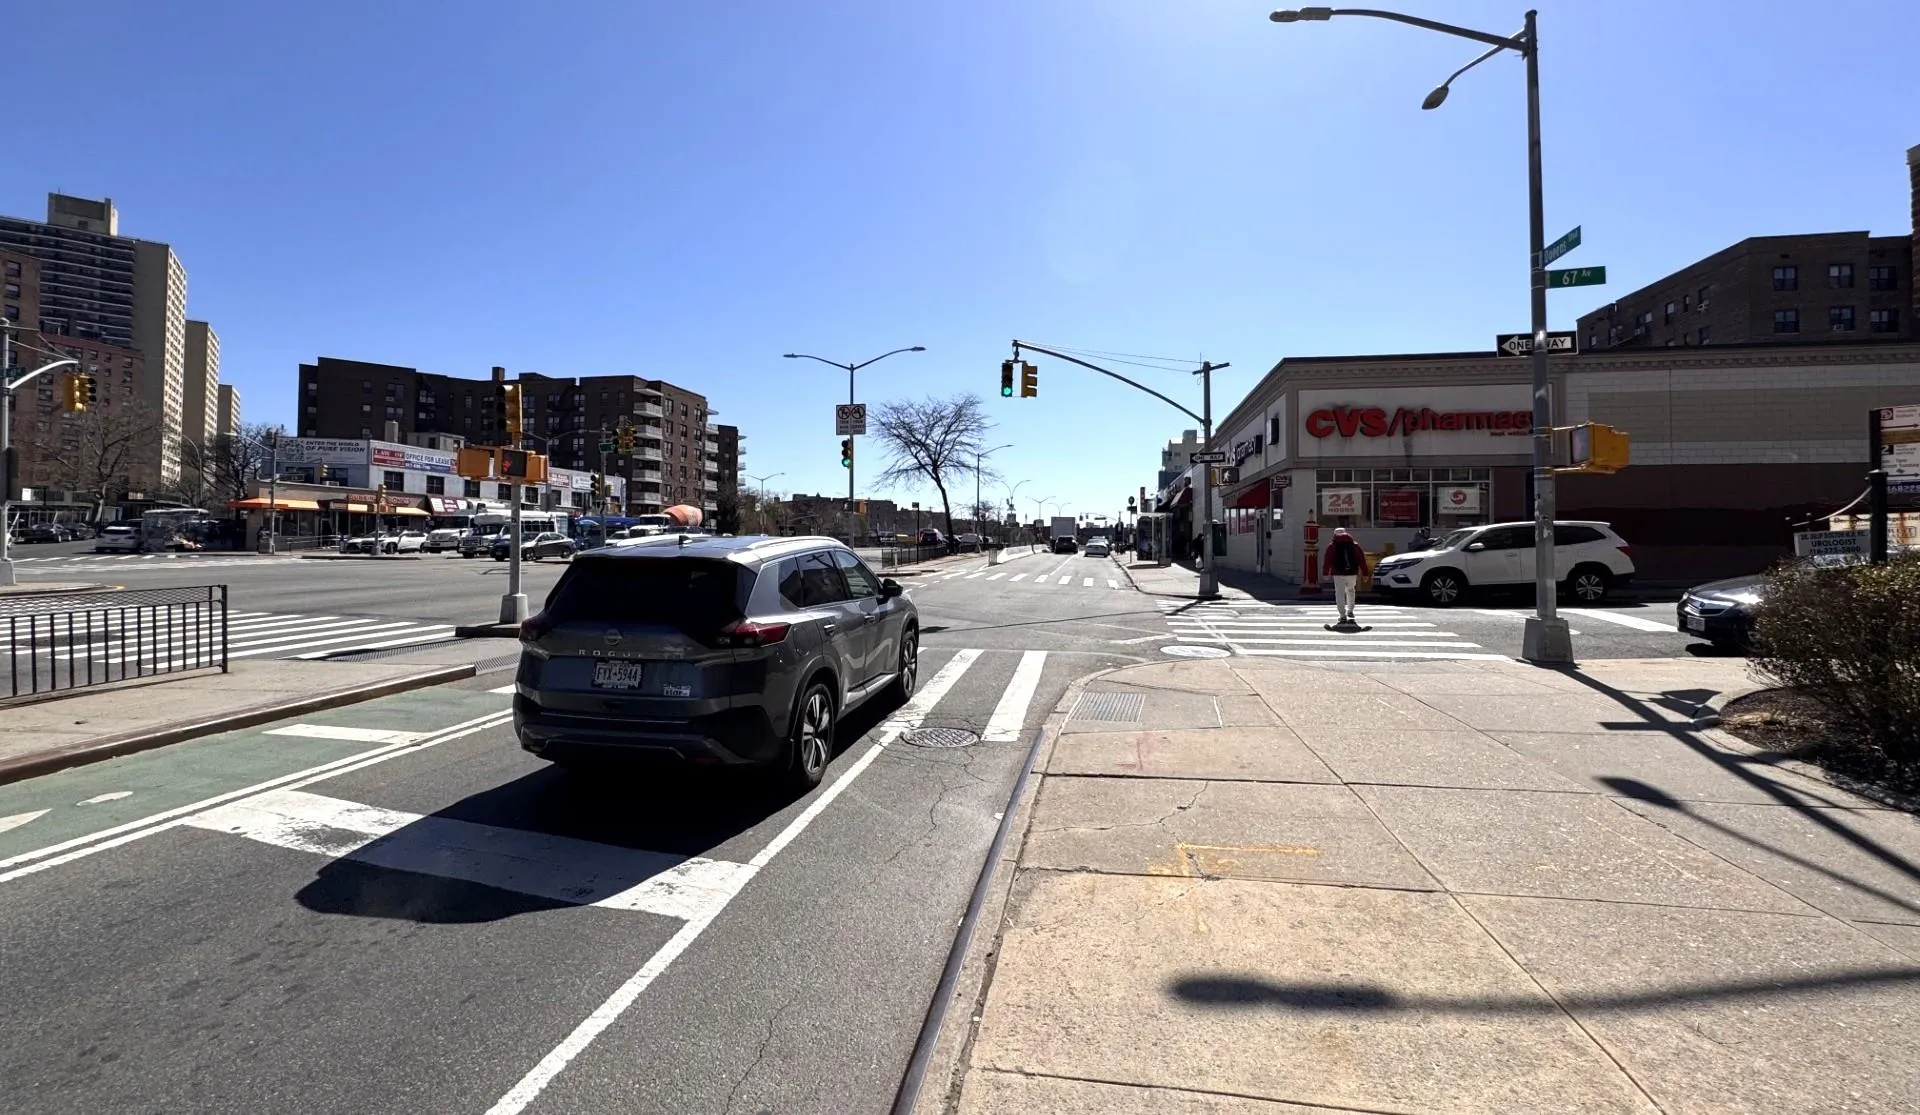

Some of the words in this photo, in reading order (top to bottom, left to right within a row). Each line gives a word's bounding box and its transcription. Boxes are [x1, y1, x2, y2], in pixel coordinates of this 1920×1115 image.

[1562, 270, 1577, 285] 67
[1509, 340, 1532, 351] ONE
[1547, 338, 1567, 349] AY
[1306, 407, 1533, 438] CVS/pharmac
[406, 453, 424, 461] OFFICE
[425, 455, 434, 463] FOR
[1328, 493, 1354, 507] 24
[1811, 539, 1857, 548] UROLOGIST
